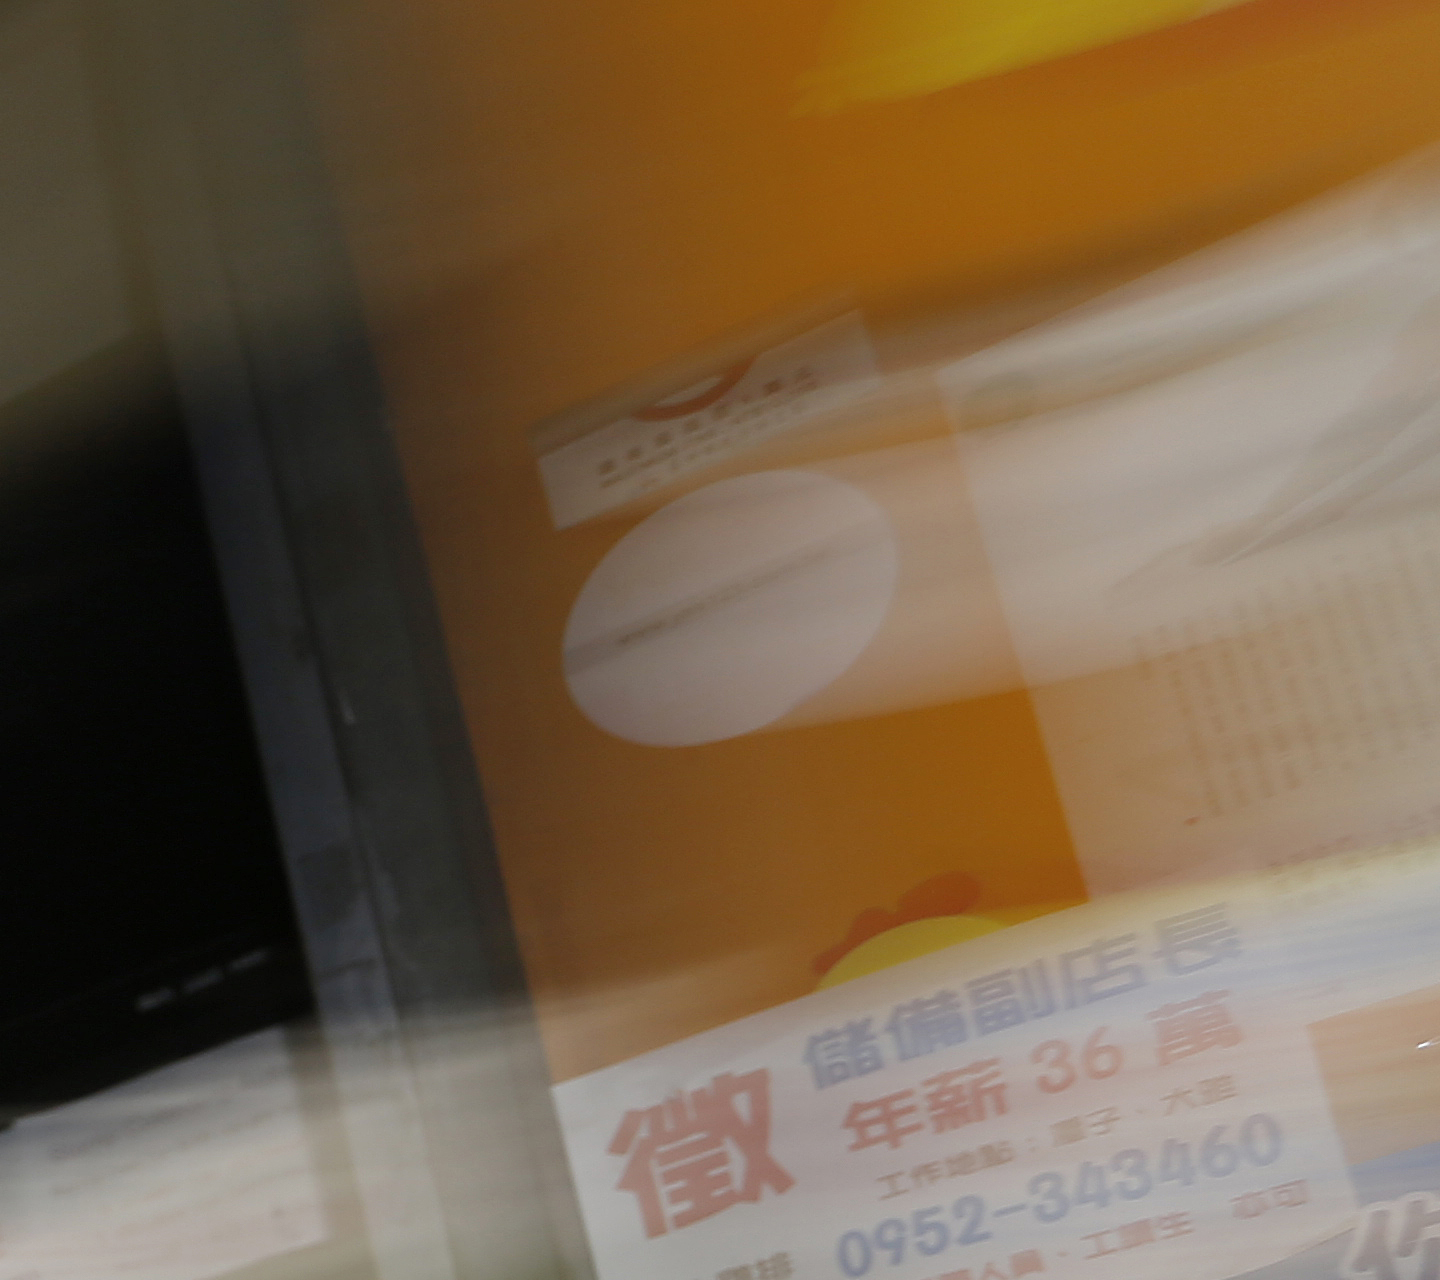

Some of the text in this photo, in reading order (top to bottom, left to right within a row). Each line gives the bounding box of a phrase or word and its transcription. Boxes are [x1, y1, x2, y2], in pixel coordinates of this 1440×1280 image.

[607, 1067, 796, 1240] 徵
[840, 1057, 1009, 1153] 年薪
[1030, 1026, 1126, 1095] 36
[836, 1112, 1286, 1280] 0952-343460
